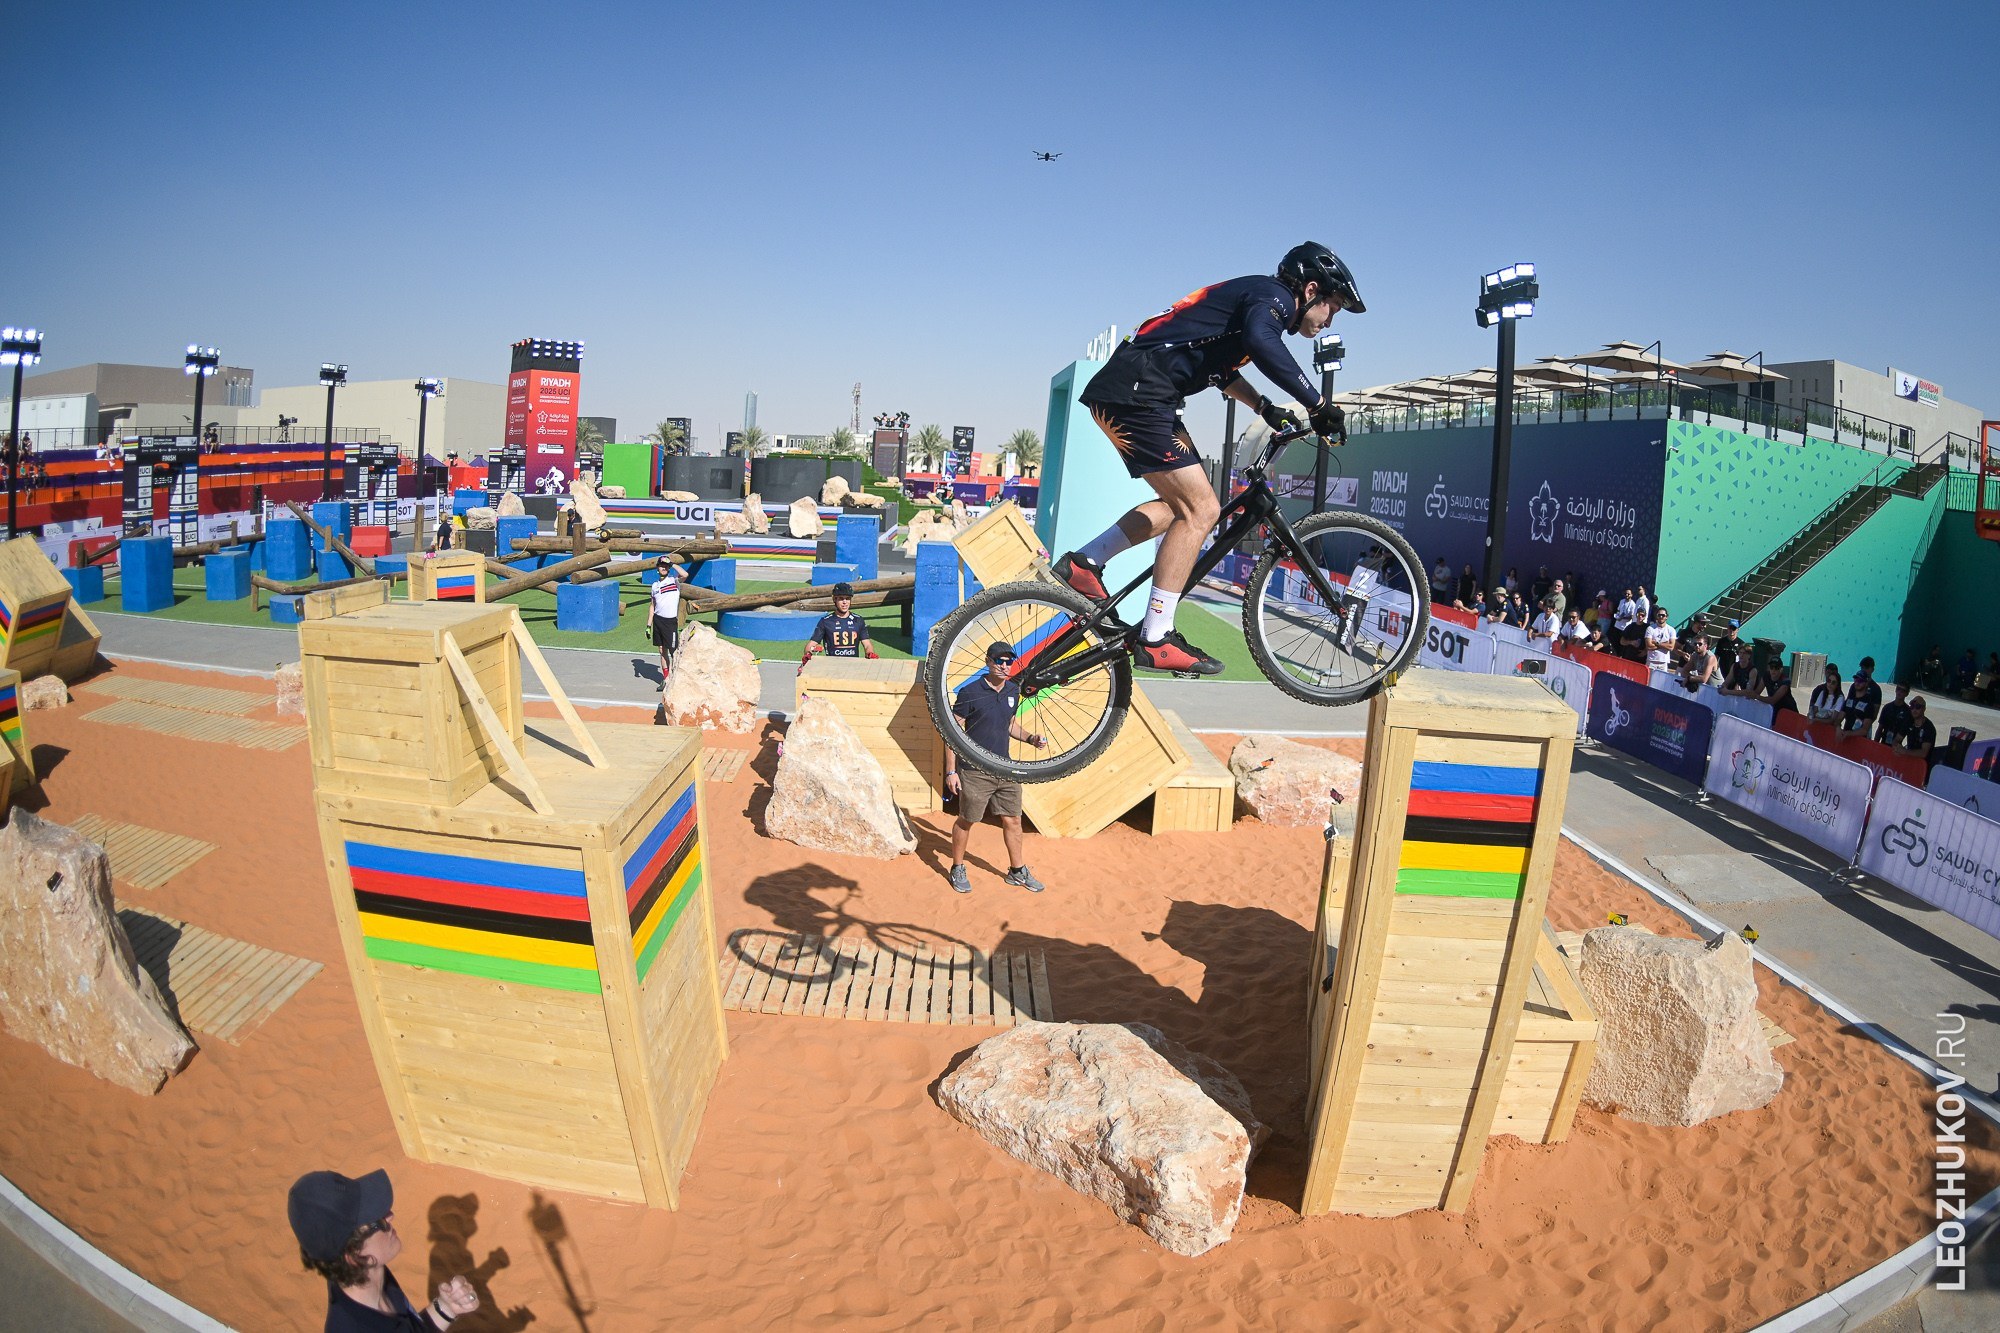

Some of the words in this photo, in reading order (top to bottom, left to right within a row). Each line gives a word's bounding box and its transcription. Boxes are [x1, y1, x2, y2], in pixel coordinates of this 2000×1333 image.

[541, 377, 571, 388] RIYADH
[144, 438, 153, 446] UCI
[1372, 470, 1408, 494] RIYADH
[397, 505, 412, 516] SOT
[1370, 497, 1389, 515] 2025
[1390, 500, 1406, 517] UCI
[1450, 495, 1473, 509] SAUDI
[1566, 496, 1604, 523] الرياضة
[1606, 499, 1636, 528] وزارة
[676, 507, 710, 522] UCI
[1564, 522, 1595, 546] Ministry
[1596, 528, 1607, 545] of
[1607, 529, 1634, 550] Sport
[1357, 571, 1371, 589] 2
[1151, 597, 1164, 614] ESP
[833, 630, 858, 646] ESP
[1654, 708, 1688, 731] RIYADH
[1652, 723, 1670, 739] 2025
[1671, 729, 1686, 745] UCI
[1771, 764, 1810, 793] الرياضة
[1812, 780, 1841, 811] وزارة
[1767, 785, 1798, 812] Ministry
[1799, 801, 1811, 815] of
[1810, 803, 1837, 828] Sport
[1935, 846, 1980, 878] SAUDI
